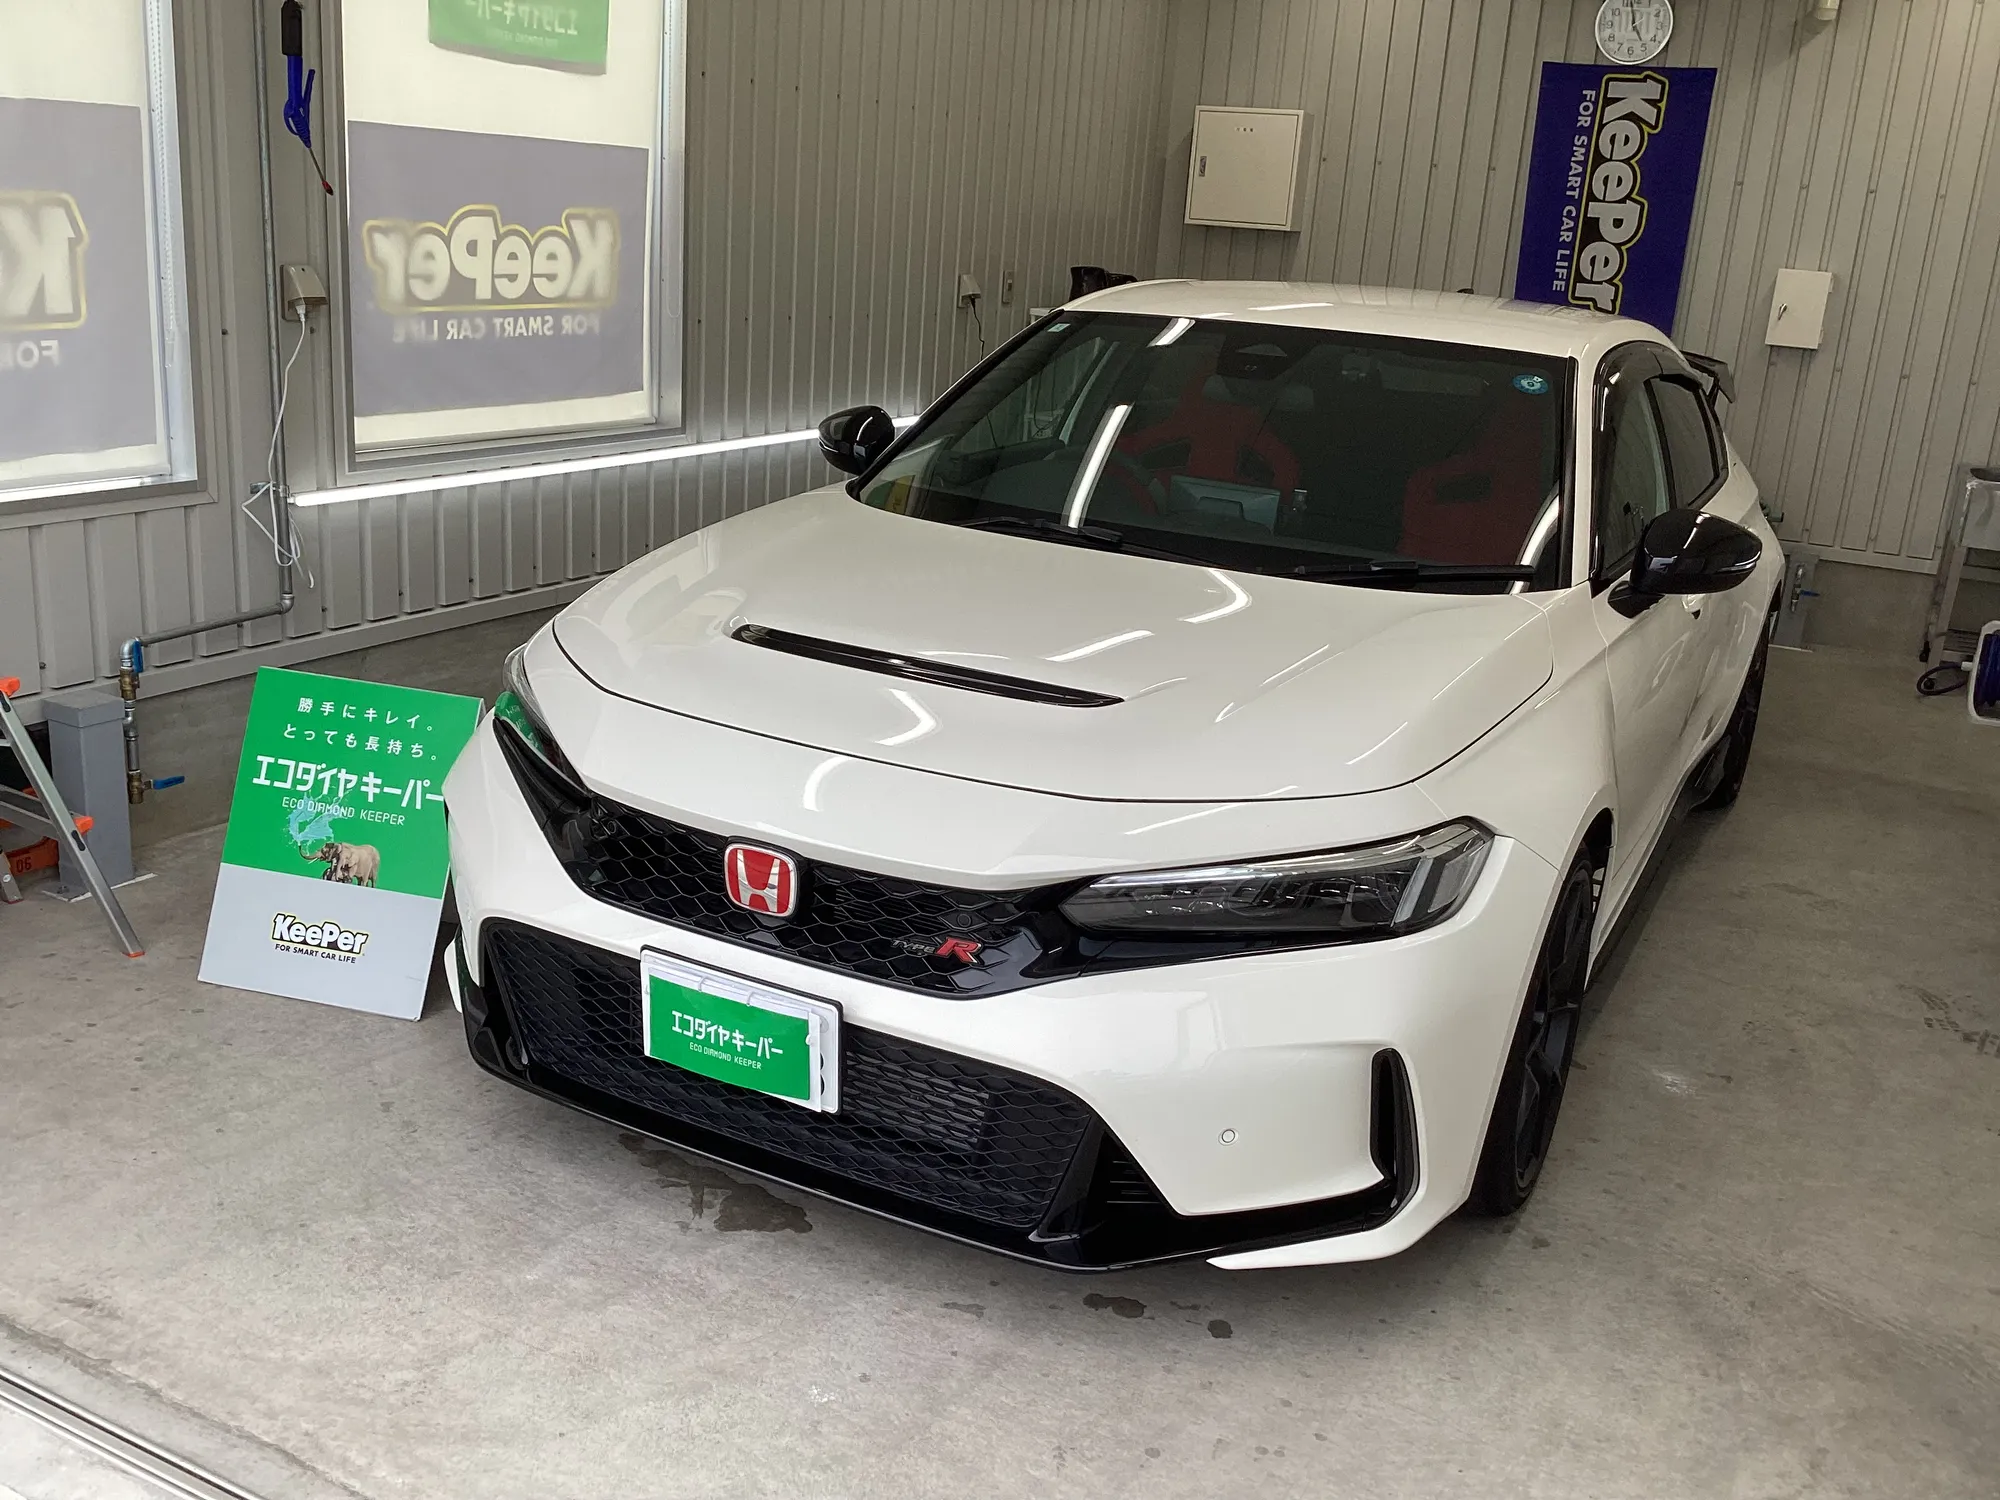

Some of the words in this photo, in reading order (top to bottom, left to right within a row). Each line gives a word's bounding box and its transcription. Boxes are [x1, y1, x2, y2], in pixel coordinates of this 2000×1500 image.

[1606, 20, 1613, 29] 9
[1608, 33, 1615, 41] 8
[1650, 34, 1657, 43] 4
[1617, 42, 1623, 51] 7
[1627, 46, 1634, 56] 6
[1640, 43, 1647, 52] 5
[1576, 89, 1596, 128] FOR
[1565, 134, 1588, 200] SMART
[1573, 77, 1664, 313] KeePer
[1558, 204, 1577, 243] CAR
[1552, 249, 1571, 293] LIFE
[297, 697, 433, 731] 勝手にキレイ。
[283, 723, 437, 762] とっても長持ち。
[252, 754, 444, 810] エコダイヤキーパー
[281, 796, 304, 810] ECO
[307, 799, 355, 819] DIAMOND
[359, 809, 406, 826] KEEPER
[271, 912, 369, 955] KeePer
[274, 943, 291, 953] FOR
[293, 946, 319, 957] SMART
[320, 951, 337, 961] CAR
[338, 954, 356, 964] LIFE
[935, 936, 982, 964] R
[671, 1010, 784, 1060] エコダイヤキーパー
[689, 1041, 703, 1053] ECO
[703, 1047, 732, 1062] DIAMOND
[734, 1054, 762, 1070] KEEPER
